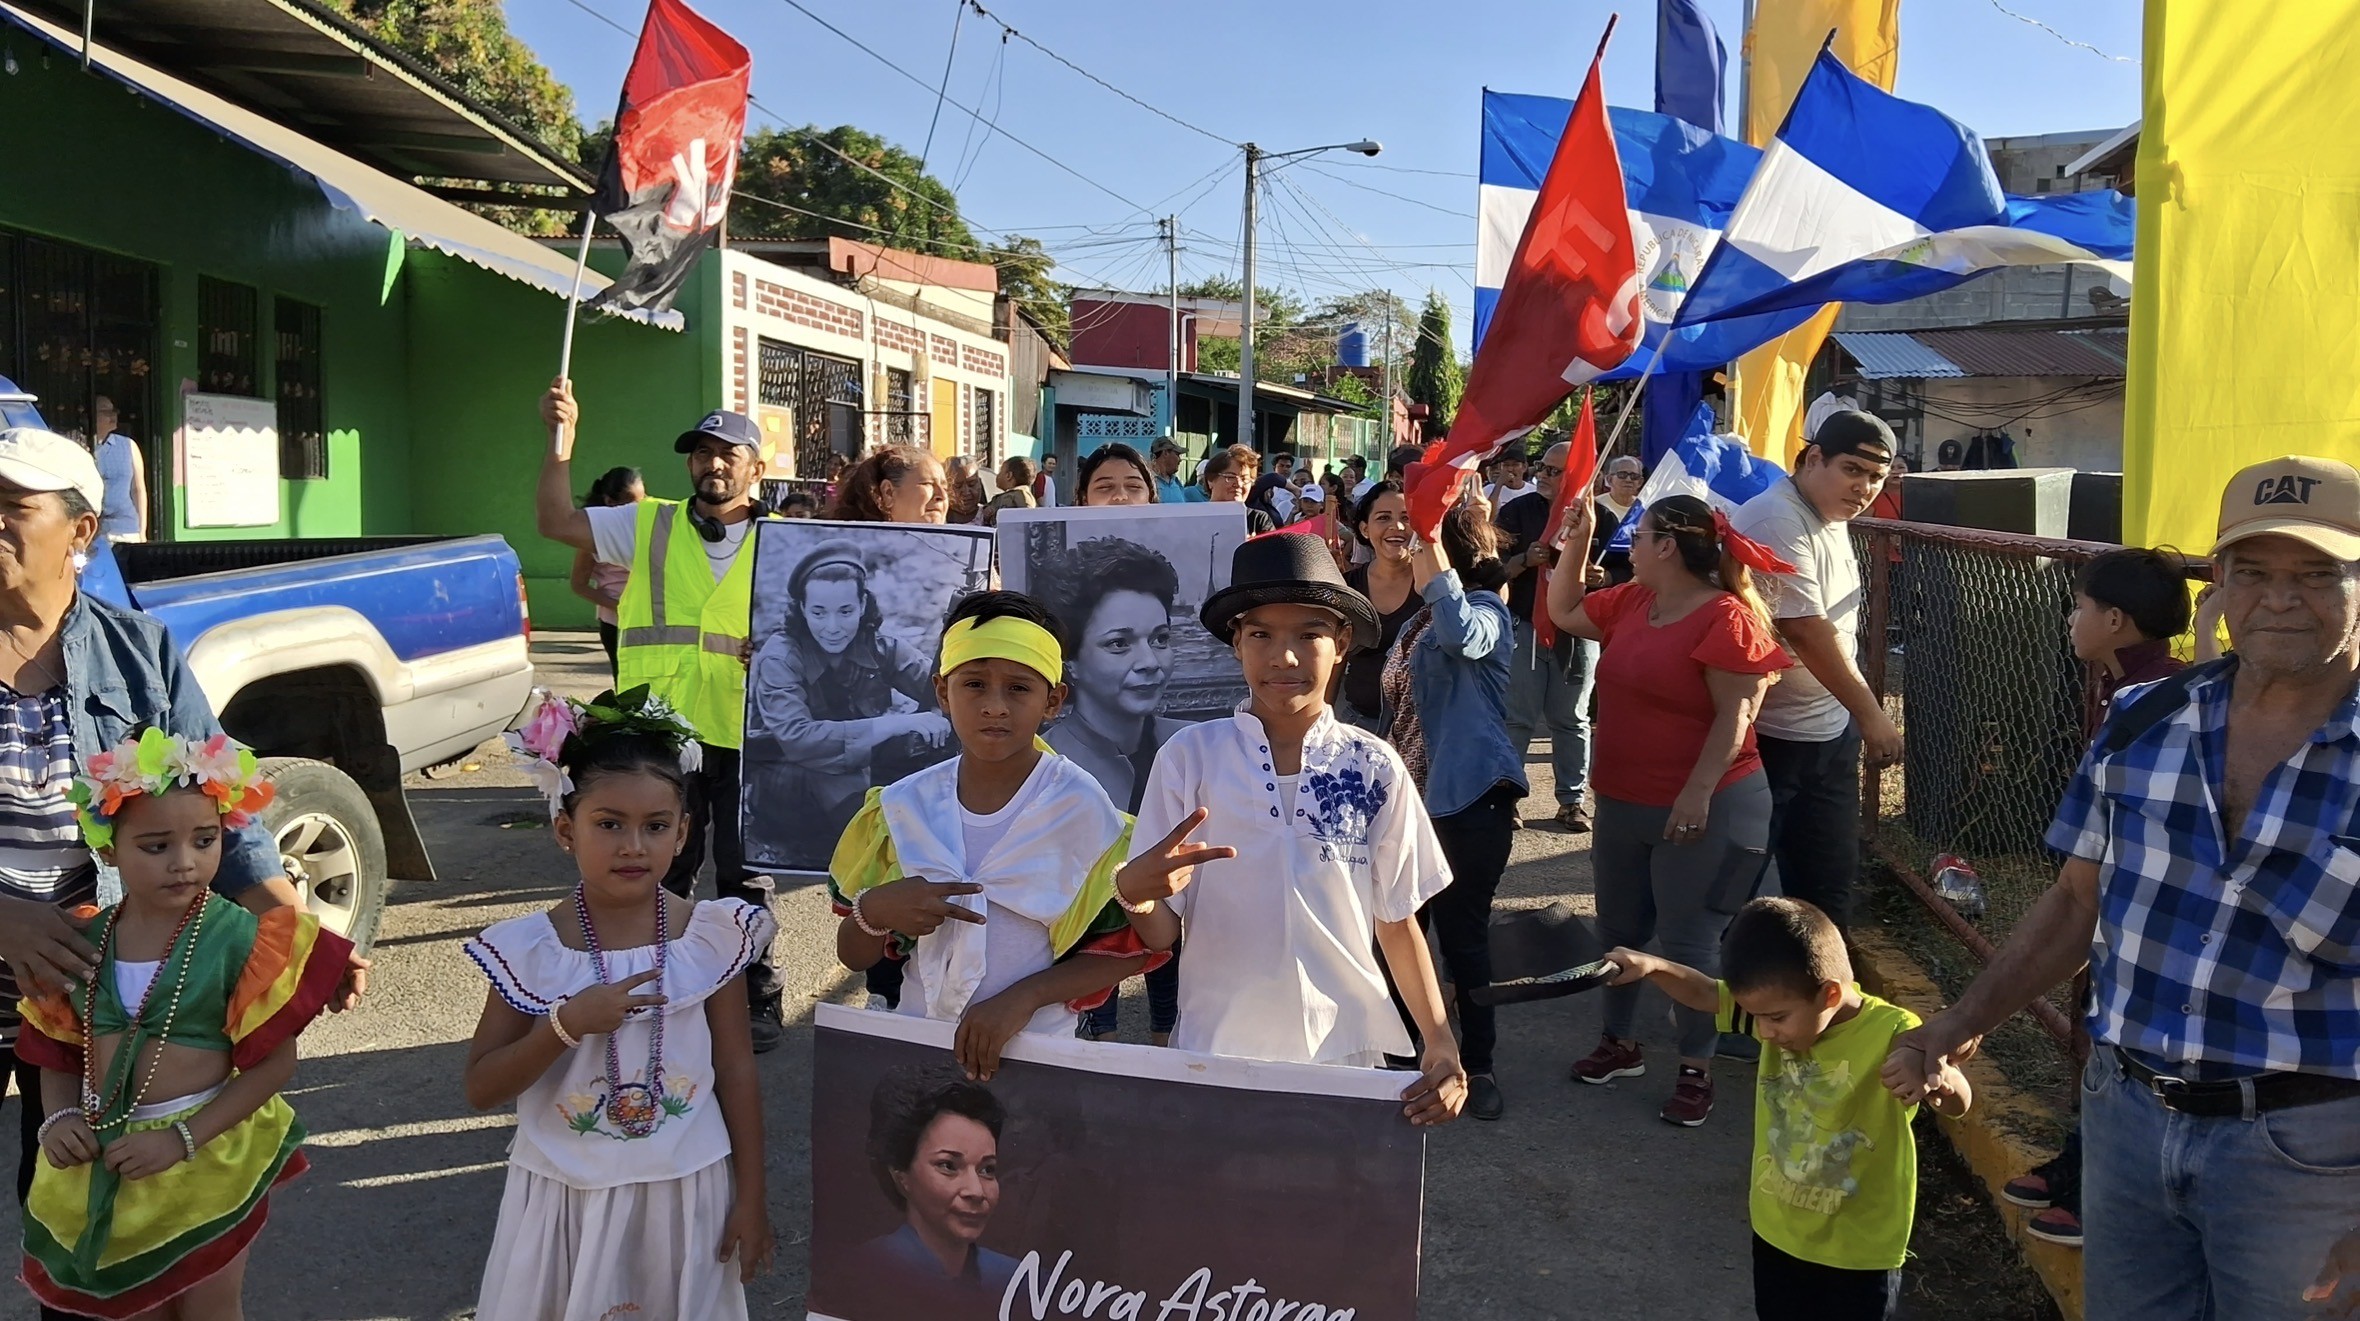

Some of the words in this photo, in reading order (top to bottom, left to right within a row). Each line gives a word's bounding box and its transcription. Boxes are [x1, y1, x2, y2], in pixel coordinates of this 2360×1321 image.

[1637, 229, 1676, 273] REPUBLICA
[2254, 475, 2317, 505] CAT
[1319, 845, 1368, 873] Nigua
[999, 1250, 1147, 1321] Nora
